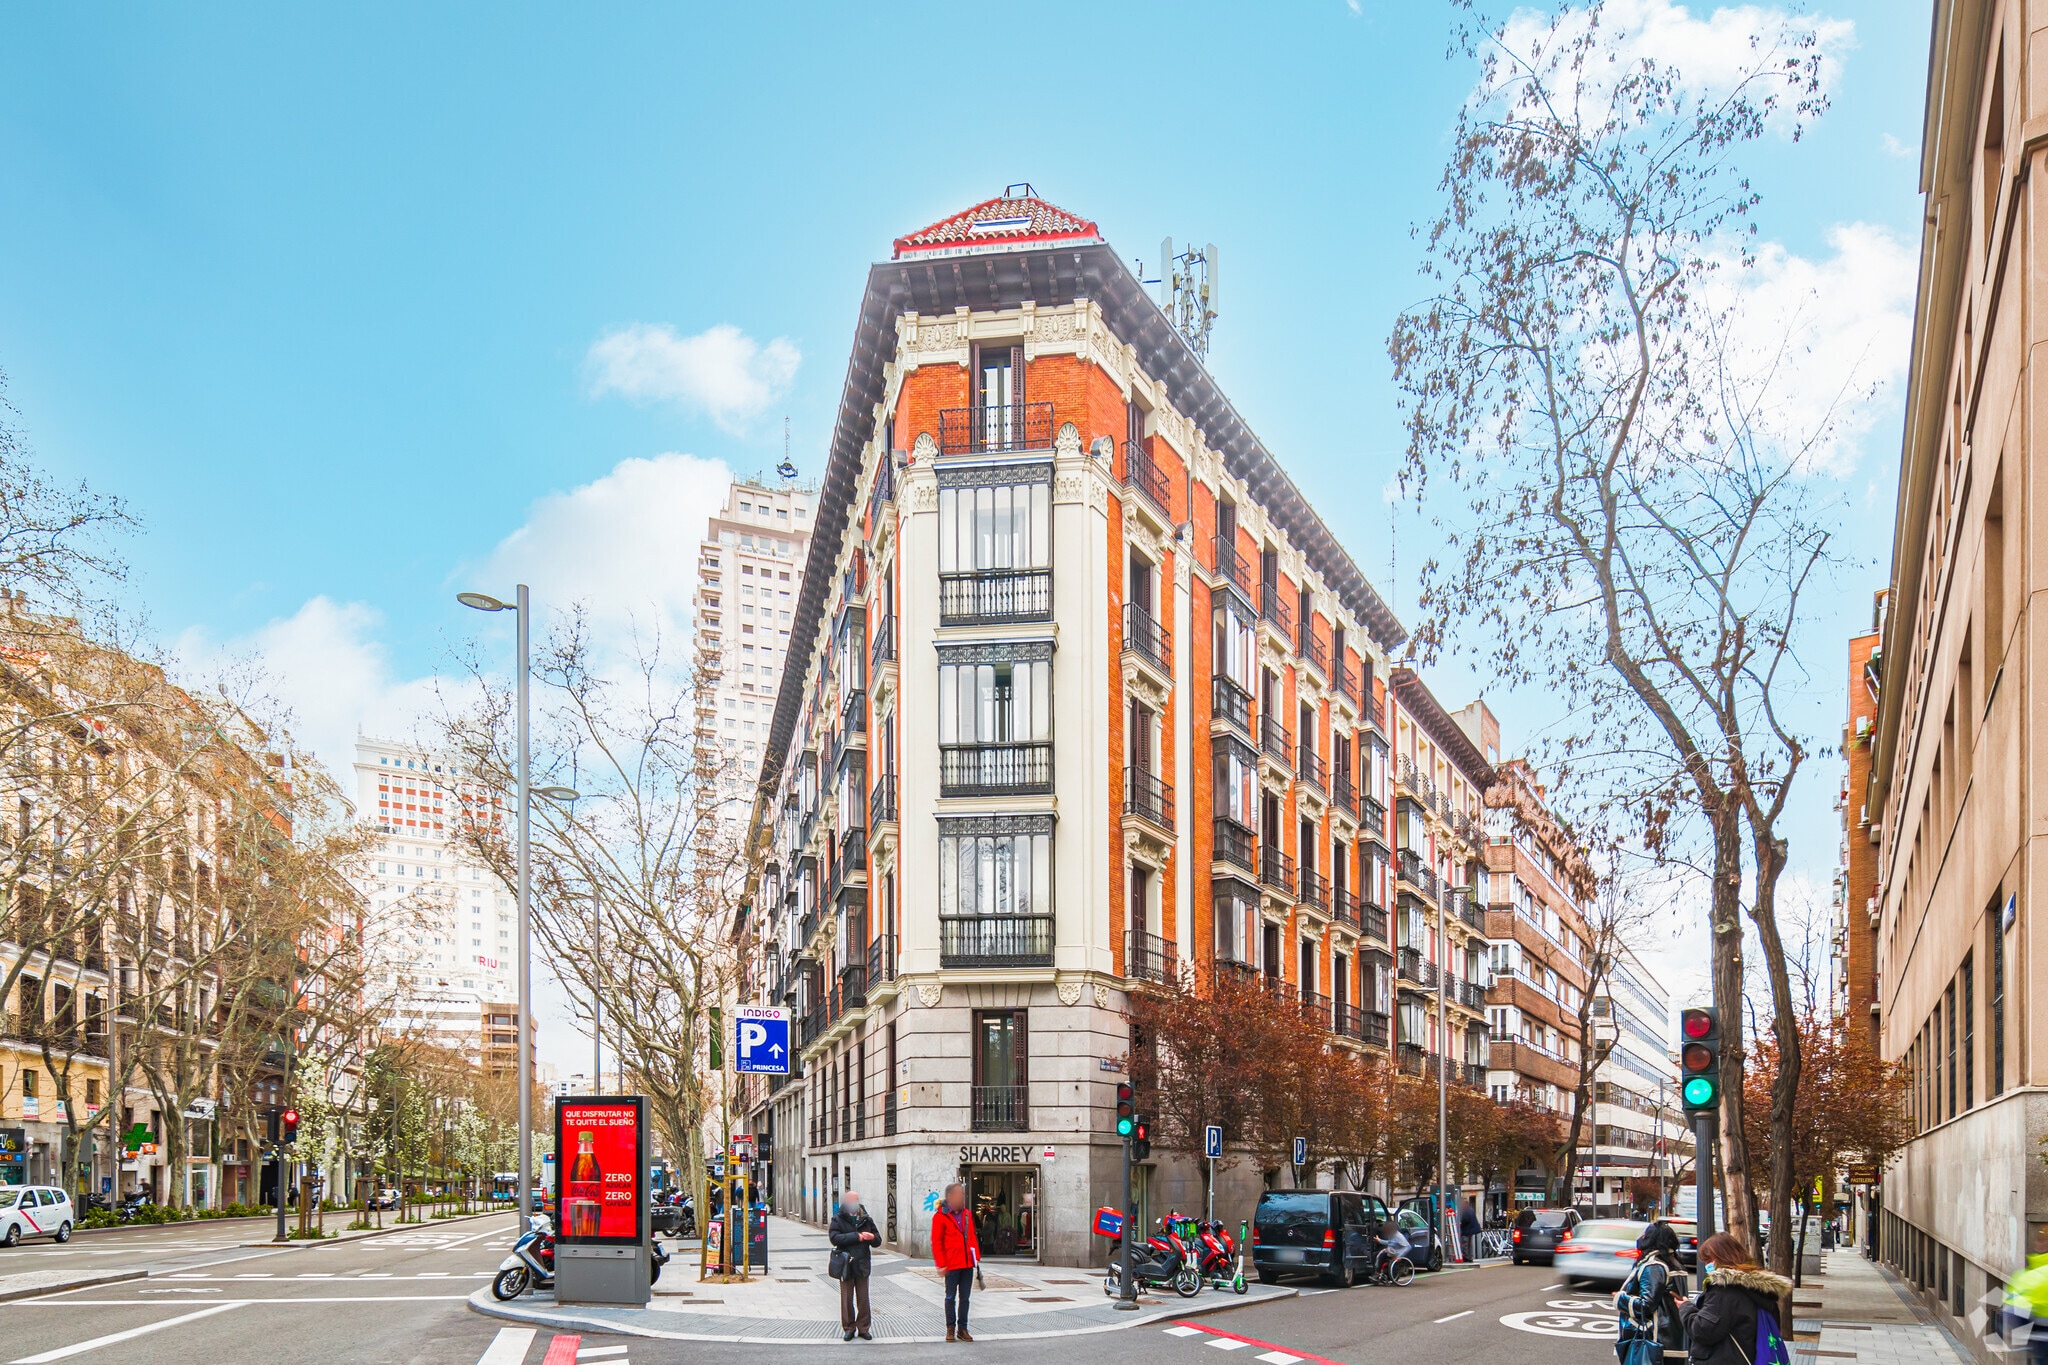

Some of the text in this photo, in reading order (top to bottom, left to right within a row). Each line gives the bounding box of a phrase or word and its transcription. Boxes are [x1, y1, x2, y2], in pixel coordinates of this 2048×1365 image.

[479, 955, 497, 969] RIU
[743, 1008, 781, 1019] INDIGO
[740, 1022, 767, 1058] P
[752, 1064, 786, 1072] PRINCESA
[565, 1110, 635, 1118] QUE DISFRUTAR NO
[565, 1117, 635, 1126] TE QUITE EL SUEÑO
[1210, 1129, 1218, 1154] P
[959, 1146, 1034, 1162] SHARREY
[1297, 1140, 1303, 1161] P
[605, 1173, 632, 1182] ZERO
[605, 1191, 632, 1200] ZERO
[1536, 1316, 1619, 1332] 30
